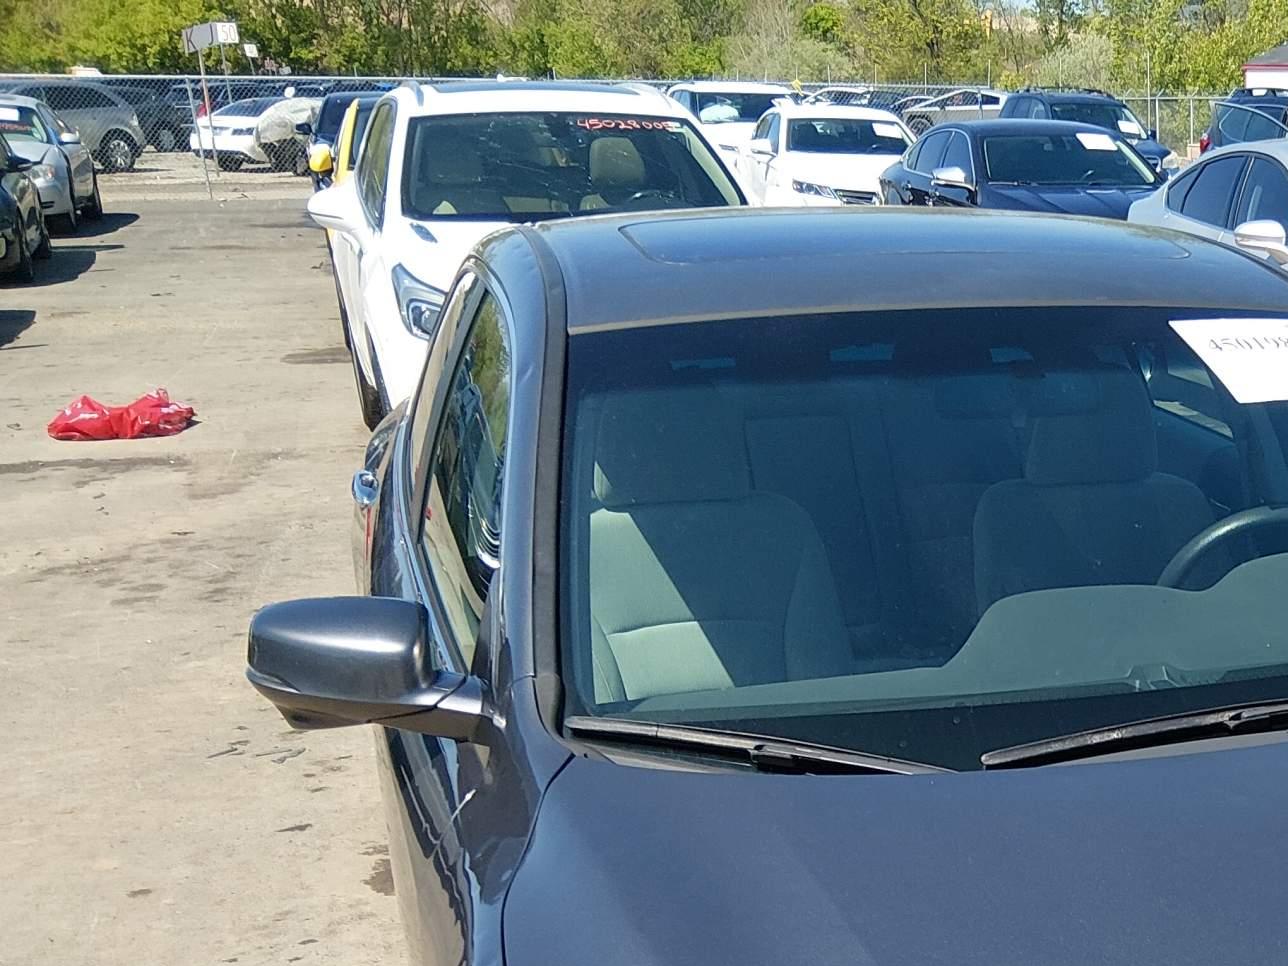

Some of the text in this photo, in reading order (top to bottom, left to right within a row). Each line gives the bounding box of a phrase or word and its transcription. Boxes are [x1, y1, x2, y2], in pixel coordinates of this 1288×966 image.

[185, 23, 214, 52] K J
[221, 24, 237, 42] 50
